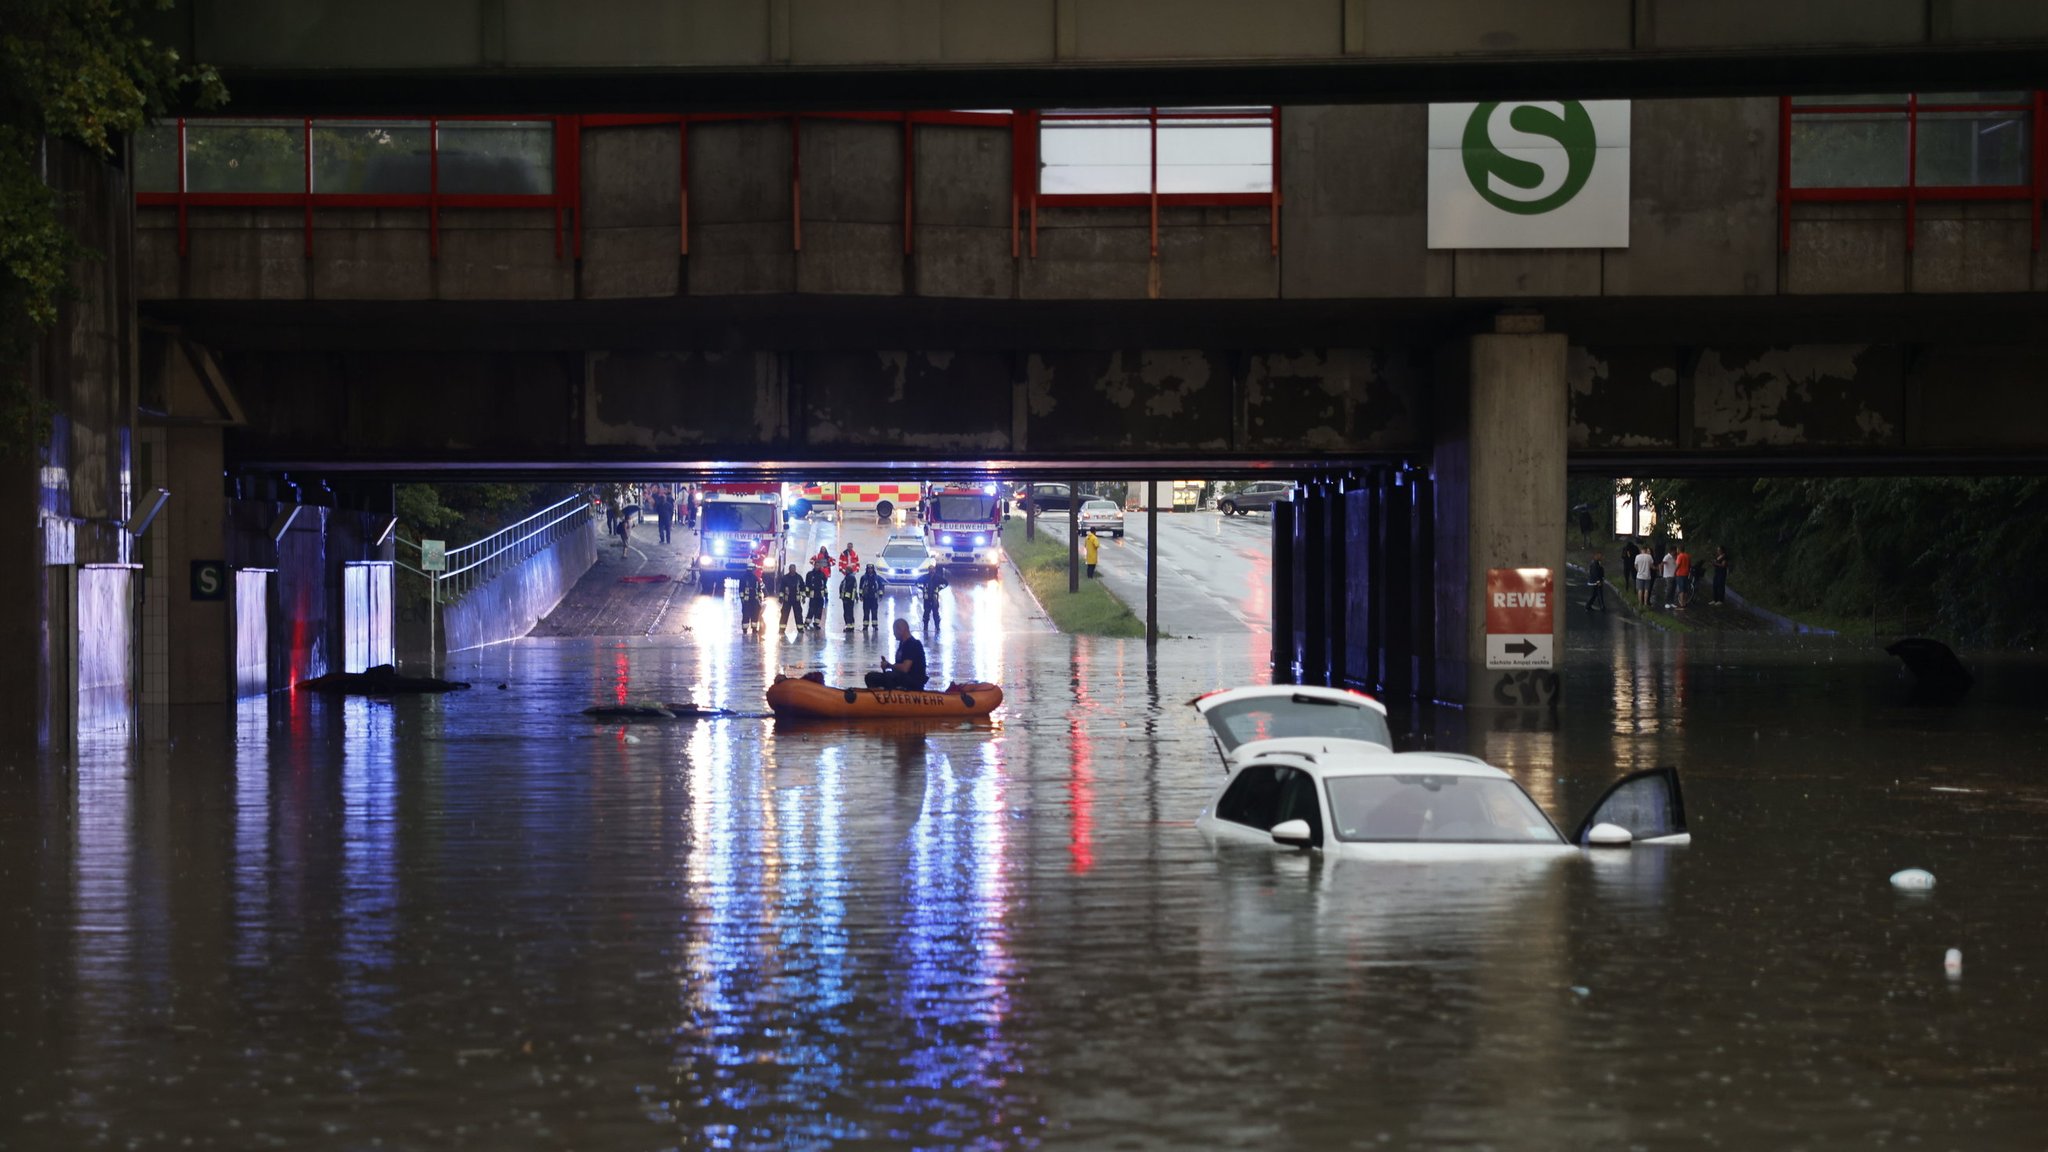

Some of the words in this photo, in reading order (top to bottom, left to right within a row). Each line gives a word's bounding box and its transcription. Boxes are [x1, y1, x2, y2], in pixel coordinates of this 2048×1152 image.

[1487, 101, 1570, 202] S
[939, 523, 988, 531] FEUERWEHR
[200, 567, 217, 593] S
[1493, 592, 1547, 608] REWE
[876, 691, 945, 706] FEUERWEHR
